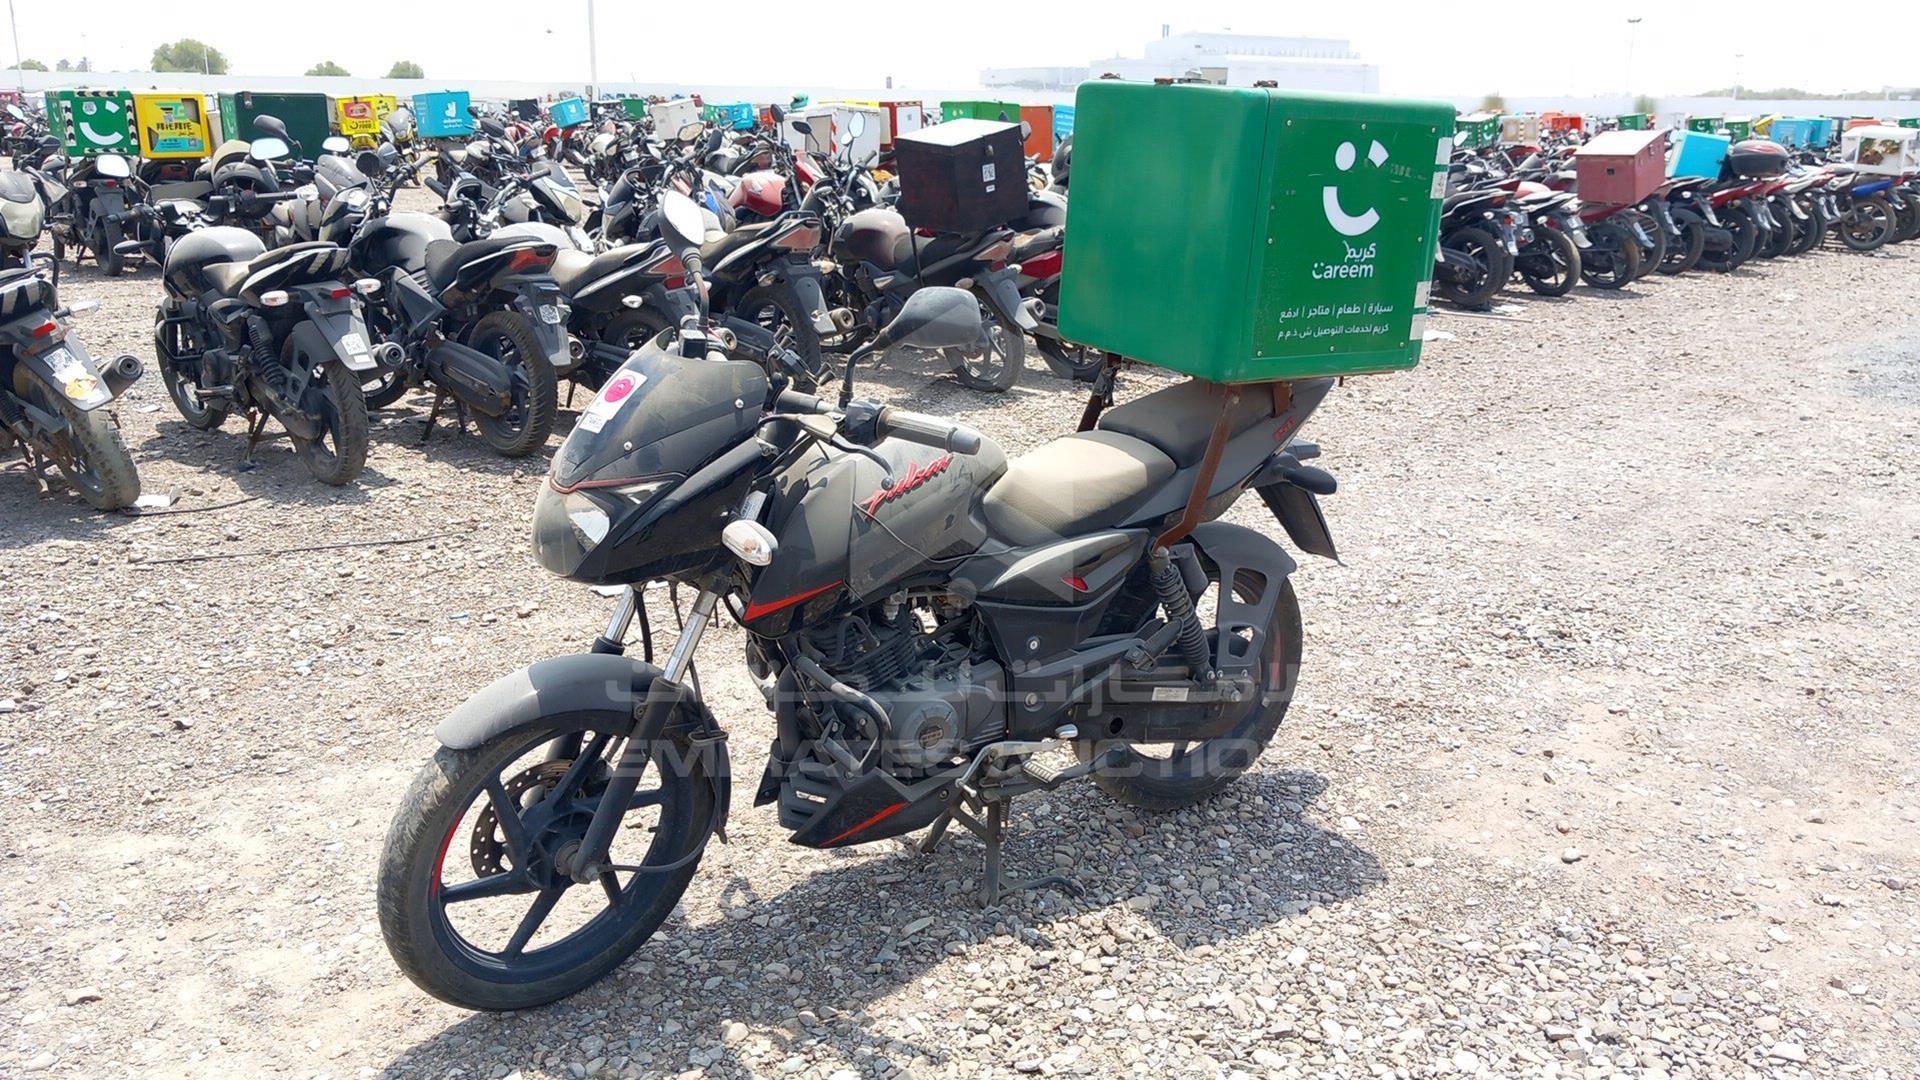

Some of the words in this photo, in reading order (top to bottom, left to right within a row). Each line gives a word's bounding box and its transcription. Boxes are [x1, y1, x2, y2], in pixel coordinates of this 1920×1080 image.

[1342, 240, 1376, 262] كريم
[1312, 262, 1374, 279] Careem
[1279, 307, 1299, 323] ادفع
[1307, 305, 1329, 319] متاجر
[1336, 303, 1361, 319] طعام
[1367, 302, 1393, 315] سيارة
[1313, 325, 1343, 338] التوصيل
[1344, 324, 1372, 335] لخدمات
[1372, 323, 1389, 335] كريم
